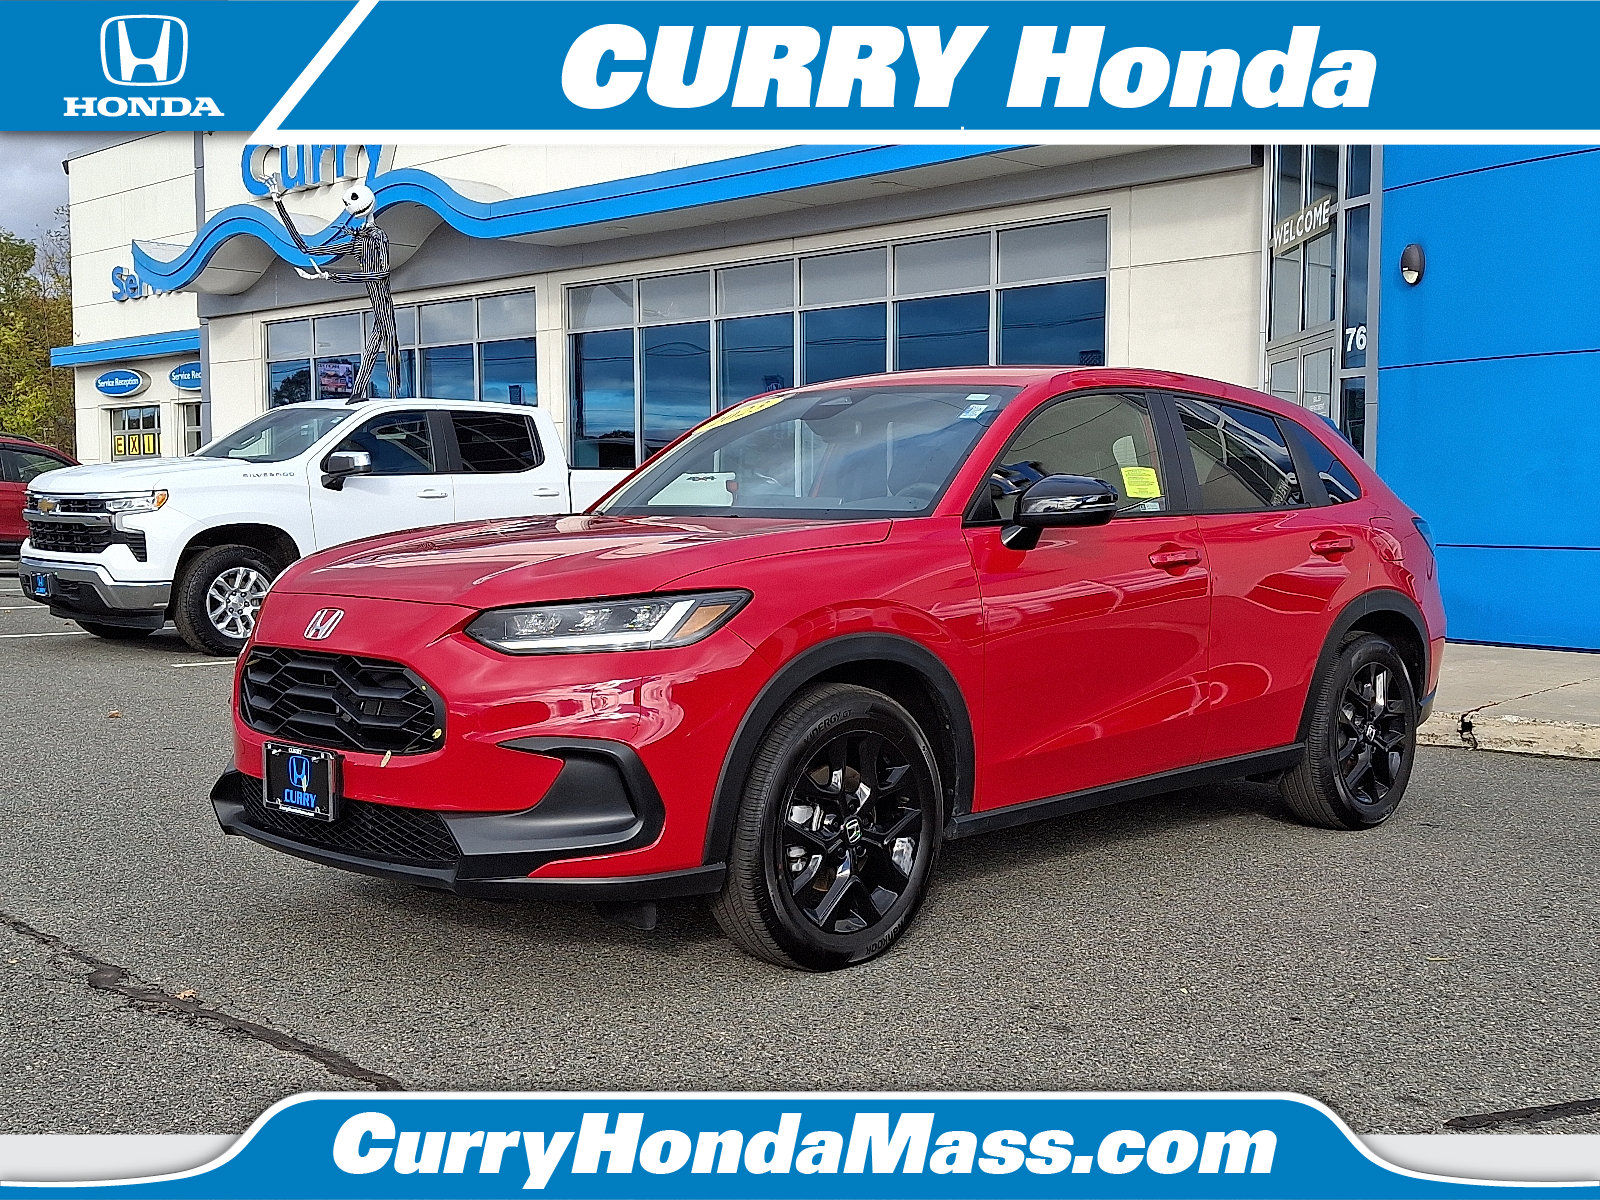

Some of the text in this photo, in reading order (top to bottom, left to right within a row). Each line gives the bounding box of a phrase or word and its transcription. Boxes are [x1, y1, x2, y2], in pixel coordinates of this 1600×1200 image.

[1273, 200, 1331, 249] WELCOME
[1345, 325, 1367, 352] 76
[97, 376, 139, 388] Service Reception
[171, 371, 191, 381] Service
[116, 435, 152, 454] EXI
[283, 788, 317, 809] CURRY
